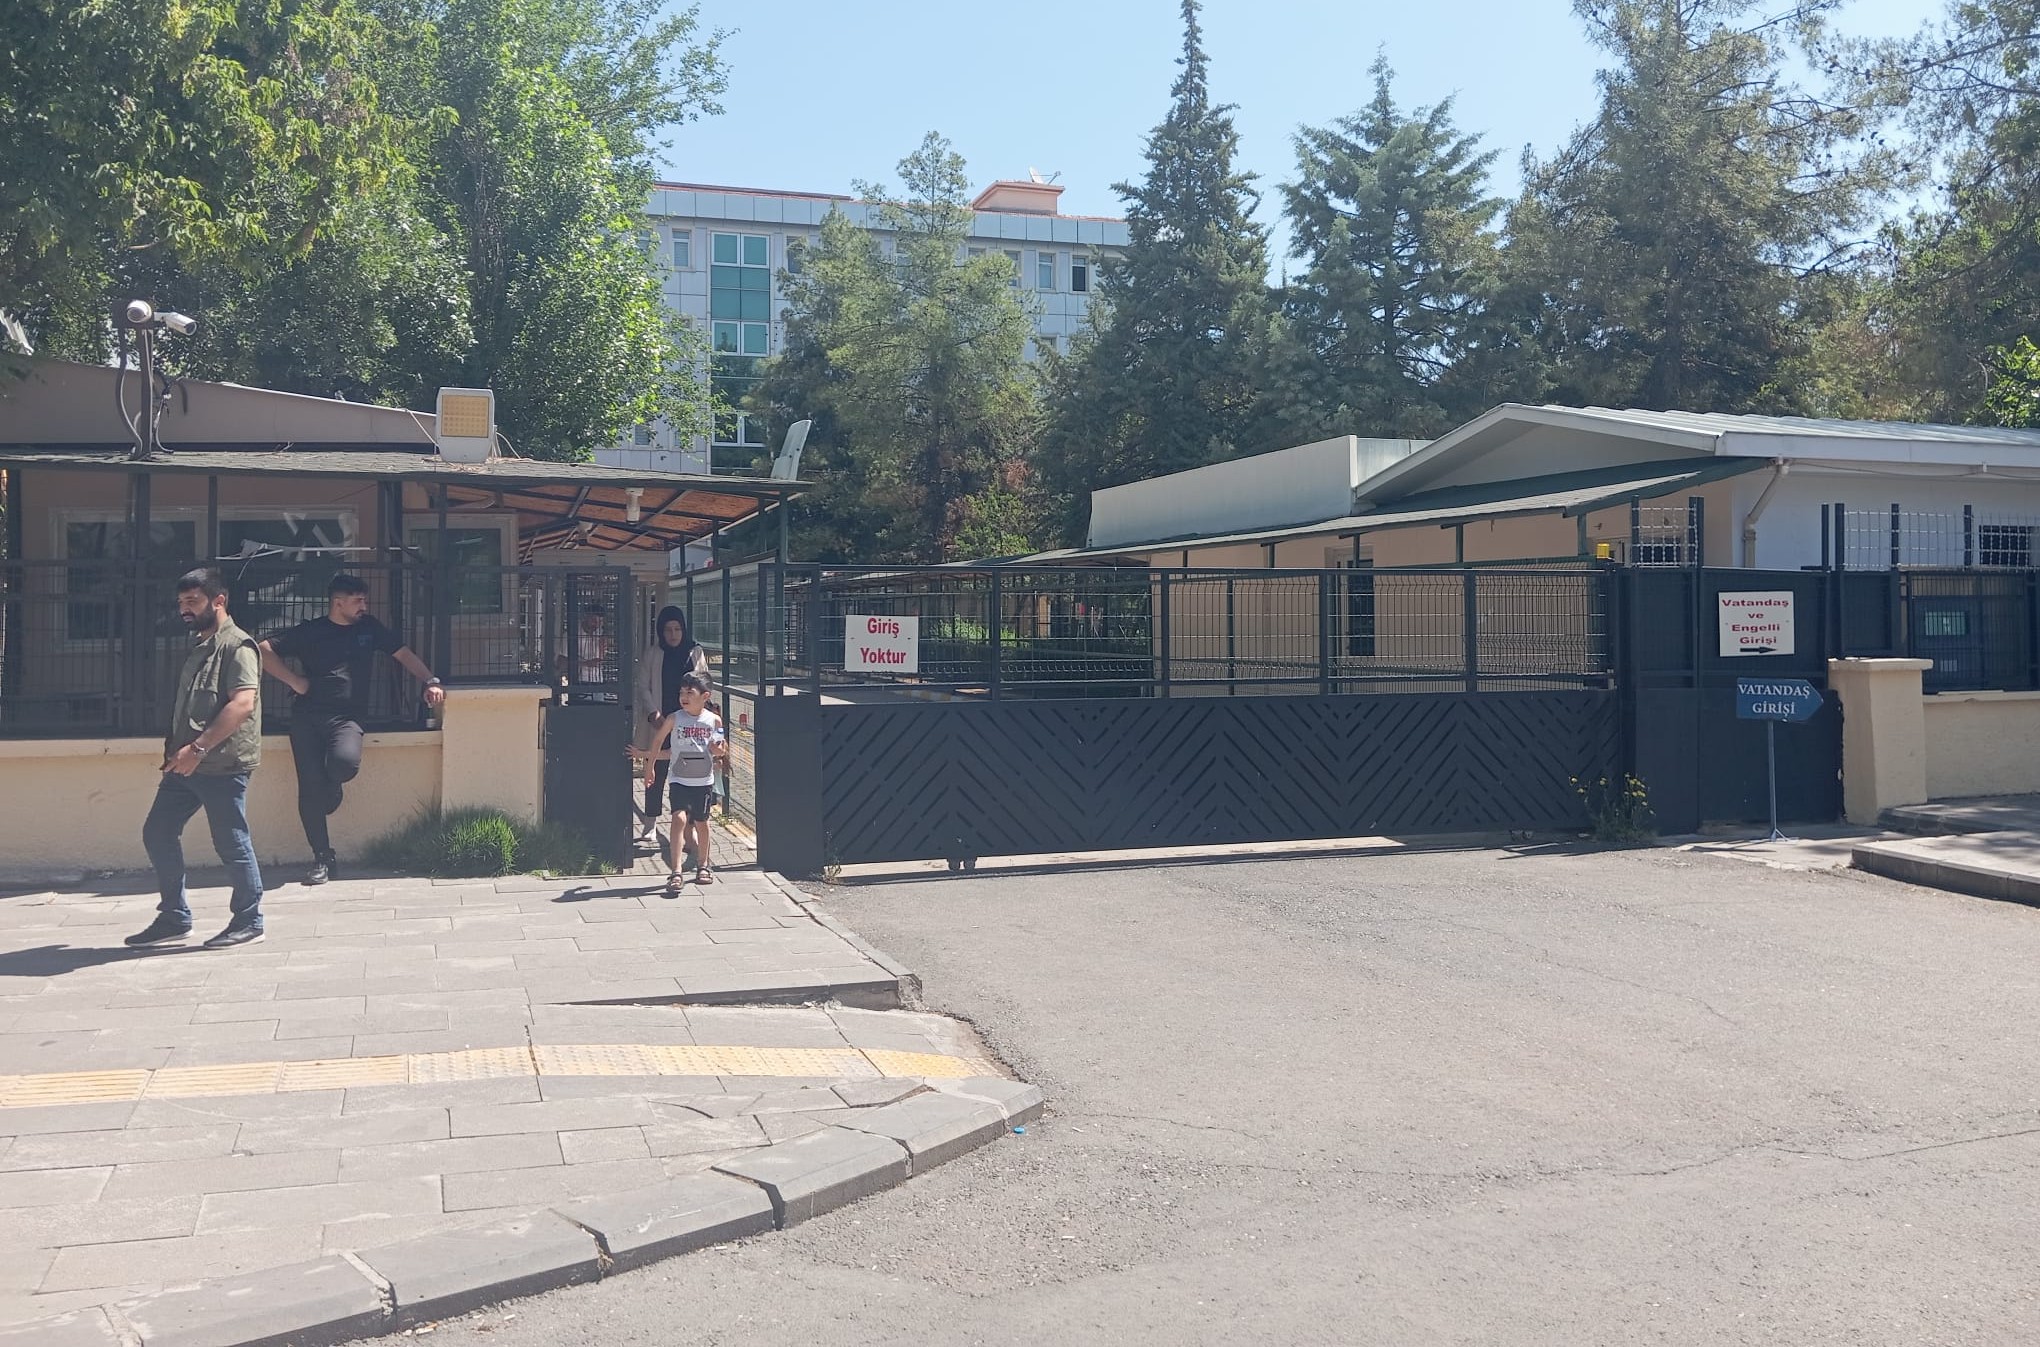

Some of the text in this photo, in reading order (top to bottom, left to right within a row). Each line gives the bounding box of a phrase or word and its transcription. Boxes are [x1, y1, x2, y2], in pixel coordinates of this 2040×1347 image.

[1722, 599, 1789, 607] Vatandaş
[867, 618, 899, 638] Giriş
[1731, 624, 1780, 633] Engelli
[1740, 636, 1777, 645] Girişi
[860, 647, 906, 664] Yoktur
[1738, 684, 1810, 699] VATANDAŞ
[1752, 701, 1795, 717] GİRİŞİ
